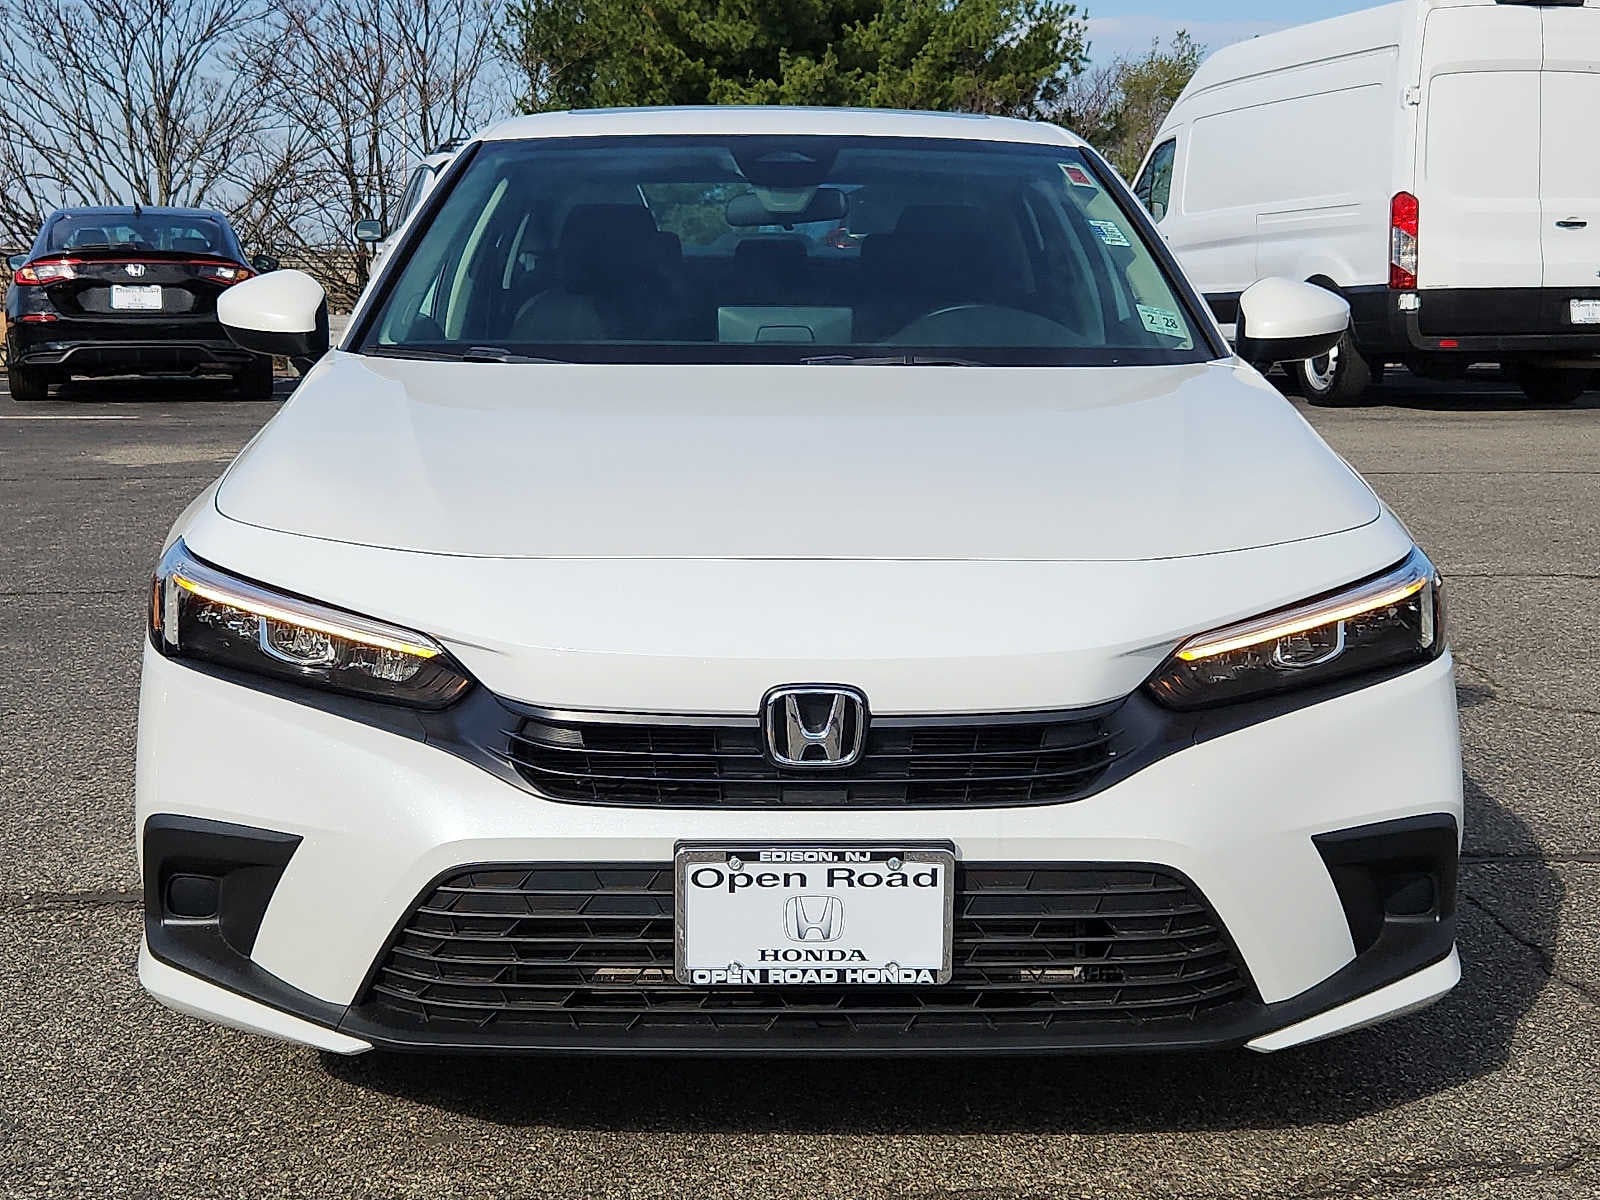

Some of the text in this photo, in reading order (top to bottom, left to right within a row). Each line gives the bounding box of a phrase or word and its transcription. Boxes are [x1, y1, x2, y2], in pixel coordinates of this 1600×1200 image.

[1147, 314, 1178, 329] 2 28
[759, 851, 871, 863] EDISON, NJ
[691, 868, 938, 893] Open Road
[758, 949, 869, 962] HONDA
[692, 969, 934, 984] OPEN ROAD HONDA
